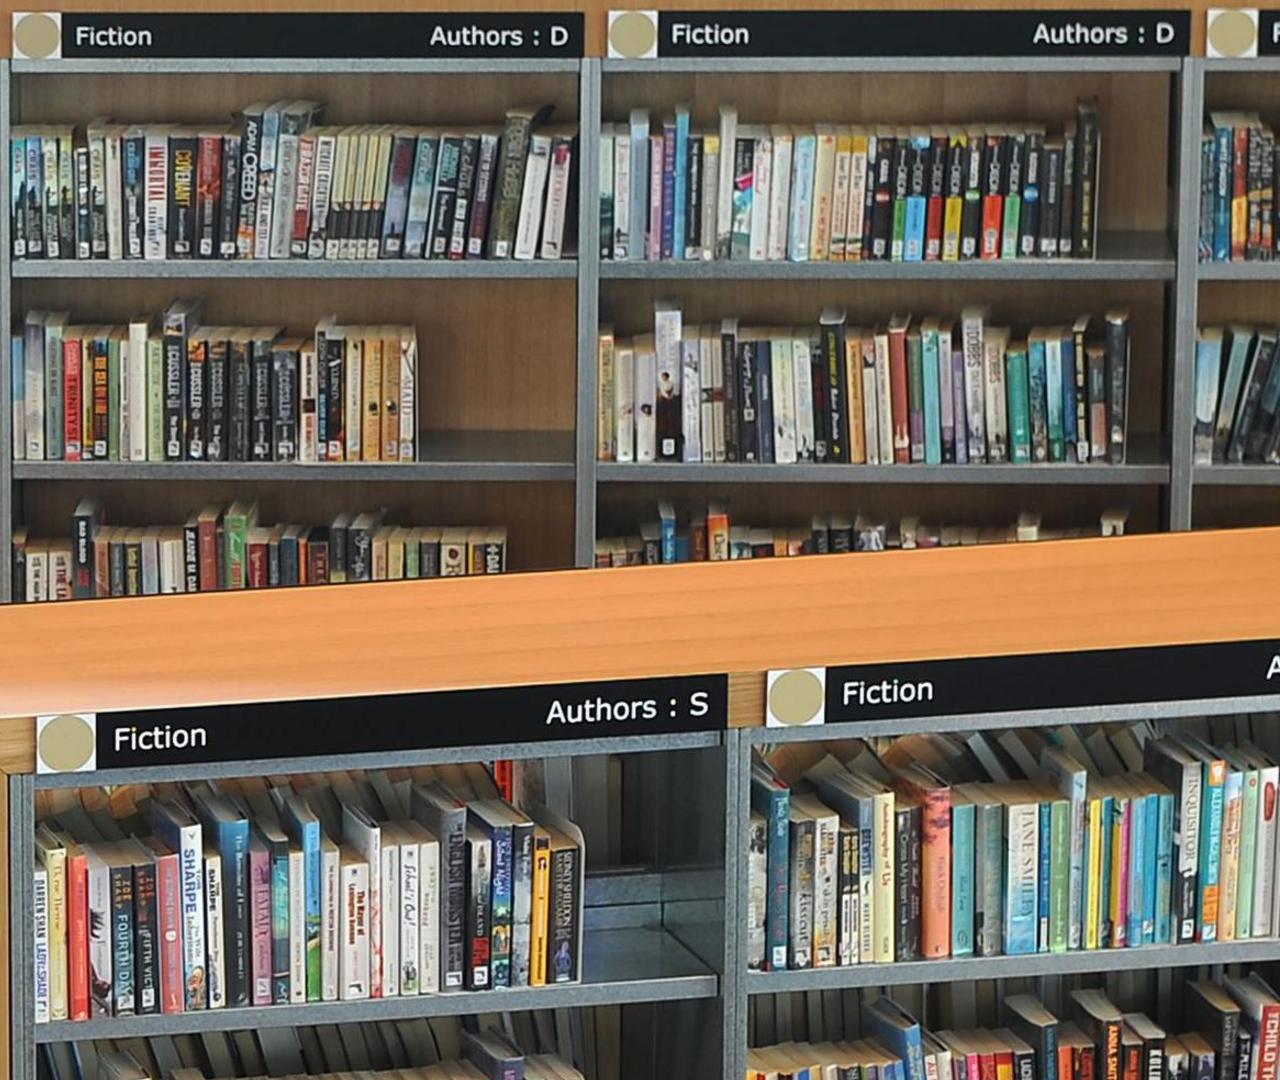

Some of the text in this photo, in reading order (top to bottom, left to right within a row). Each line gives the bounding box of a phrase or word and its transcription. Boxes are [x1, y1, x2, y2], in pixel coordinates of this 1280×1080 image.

[76, 26, 152, 46] Fiction
[430, 26, 523, 46] Authors
[550, 26, 569, 46] D
[672, 24, 749, 45] Fiction
[1032, 23, 1128, 44] Authors
[1156, 23, 1175, 44] D
[149, 146, 165, 202] IMMORTAL
[174, 150, 190, 206] COVENANT
[242, 120, 257, 200] ADAM CREED
[191, 369, 202, 407] CUSSLER
[545, 696, 648, 725] Authors
[689, 691, 709, 717] S
[842, 678, 934, 706] Fiction
[114, 724, 207, 752] Fiction
[1183, 778, 1199, 861] INQUISITOR
[183, 848, 198, 913] SHARPE
[446, 833, 466, 883] ENGLISH
[1020, 811, 1034, 920] JANE SMILEY
[402, 863, 418, 927] School's Out!
[798, 893, 812, 942] kisscut
[117, 914, 132, 995] FOURTH DAY
[1262, 1023, 1278, 1062] CHILD
